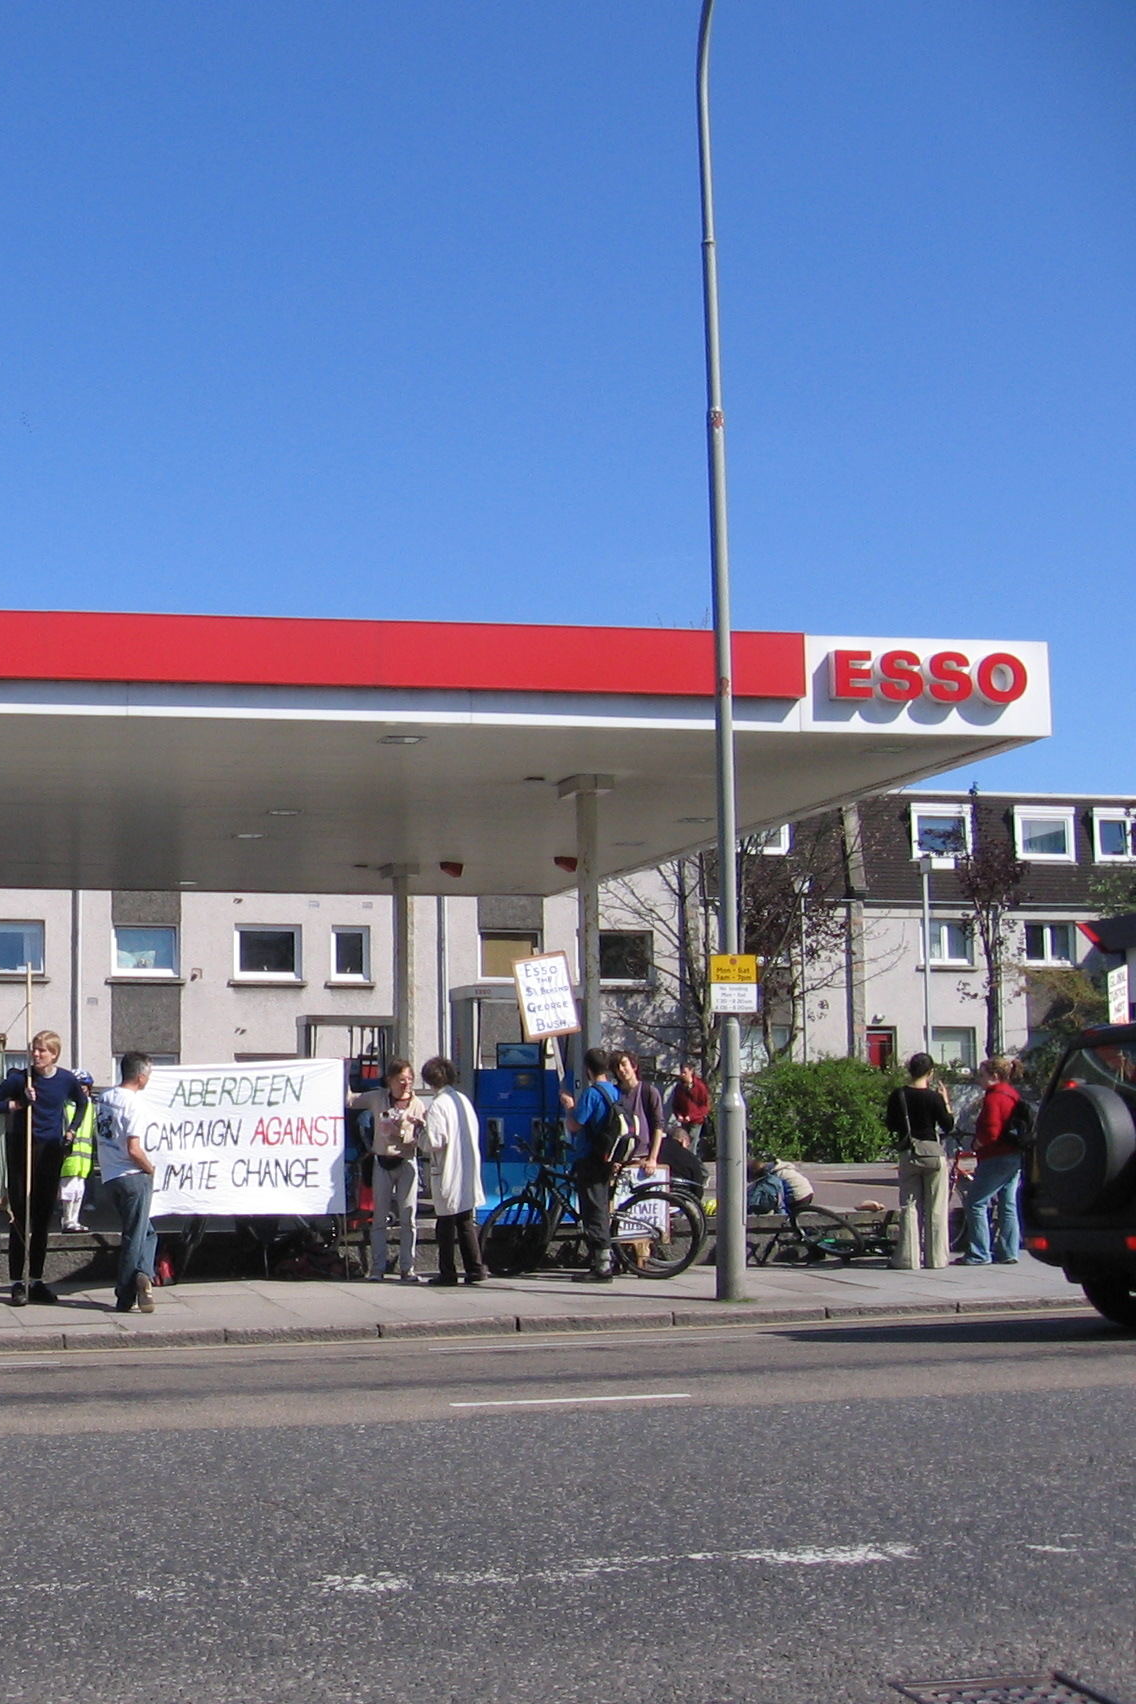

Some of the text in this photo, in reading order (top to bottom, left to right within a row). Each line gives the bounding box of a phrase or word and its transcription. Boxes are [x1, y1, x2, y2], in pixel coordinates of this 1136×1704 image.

[828, 649, 1028, 704] ESSO
[524, 963, 558, 978] ESSO
[527, 1000, 569, 1013] GEORGE
[168, 1074, 305, 1108] ABERDEEN
[144, 1116, 345, 1152] CAMPAIGN AGAINST
[152, 1158, 320, 1192] IMATE CHANGE
